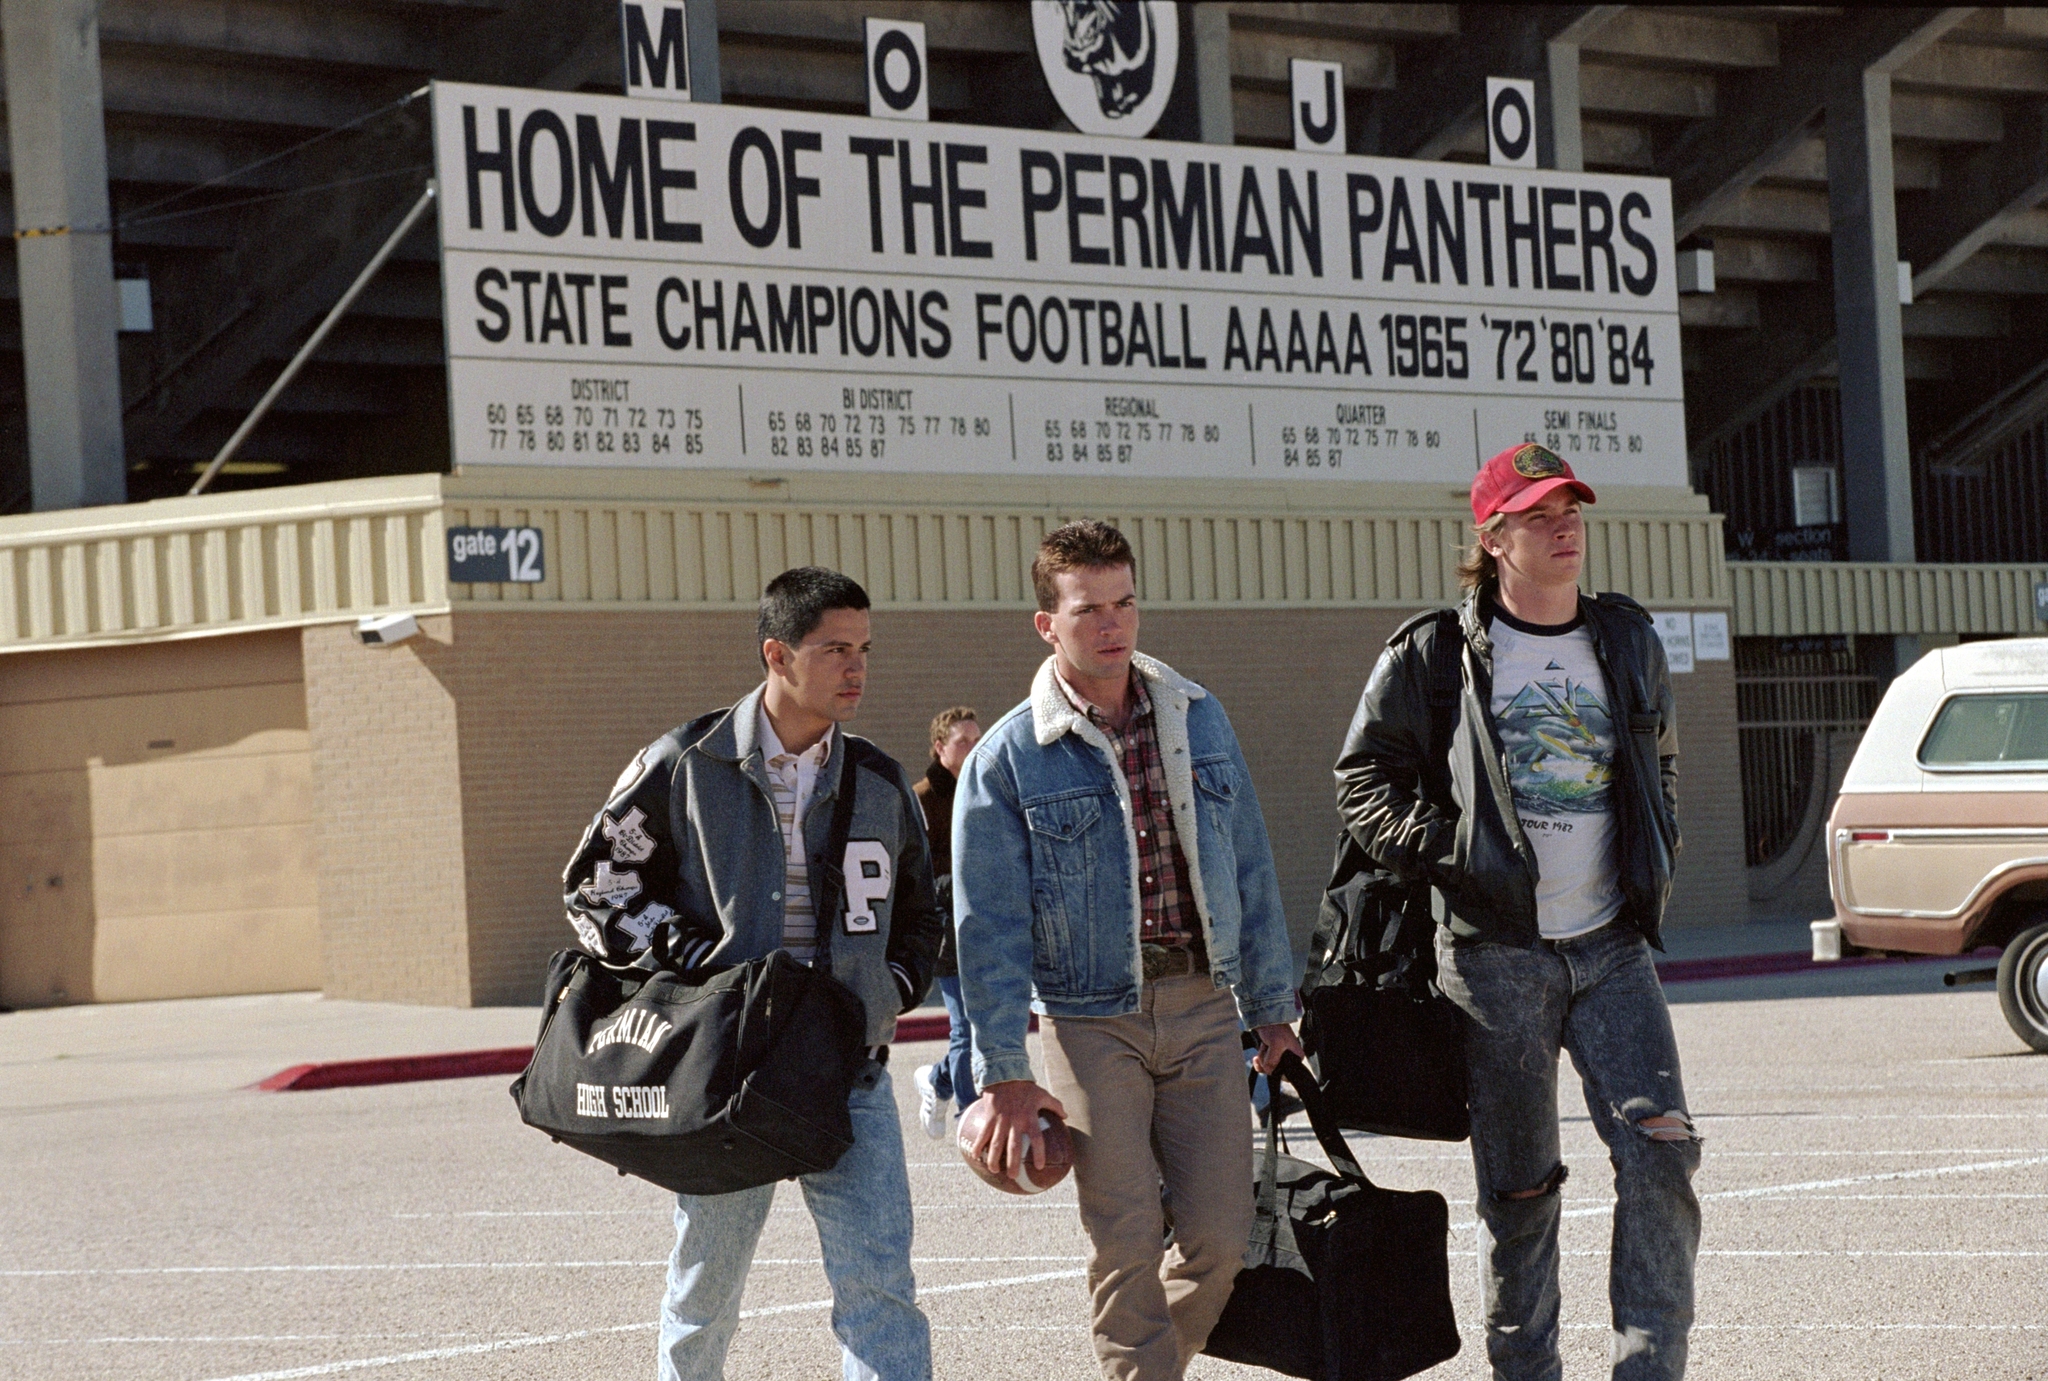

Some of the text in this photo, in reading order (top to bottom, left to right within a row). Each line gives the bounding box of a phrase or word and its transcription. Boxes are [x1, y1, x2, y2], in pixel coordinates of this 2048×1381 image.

[625, 4, 1532, 160] M O J O
[462, 105, 1658, 297] HOME OF THE PERMIAN PANTHERS
[474, 267, 632, 347] STATE
[656, 276, 952, 359] CHAMPIONS
[976, 292, 1207, 370] FOOTBALL
[1223, 306, 1373, 376] AAAAA
[1379, 313, 1469, 379] 1965
[571, 379, 629, 402] DISTRICT
[843, 388, 912, 411] BI DISTRICT
[487, 404, 703, 429] 60 65 68 70 71 72 73 75
[1105, 396, 1159, 419] REGIONAL
[1336, 403, 1386, 425] QUARTER
[769, 411, 990, 437] 65 68 70 72 73 75 77 78 80
[1045, 420, 1220, 443] 65 68 70 72 75 77 78 80
[1544, 409, 1617, 432] SEMI FINALS
[489, 429, 703, 455] 77 78 80 81 82 83 84 85
[771, 436, 885, 458] 82 83 84 85 87
[1282, 426, 1440, 448] 65 68 70 72 75 77 78 80
[1547, 432, 1560, 451] 68
[1568, 433, 1581, 452] 70
[1587, 434, 1600, 452] 72
[1608, 435, 1620, 453] 75
[1628, 435, 1642, 453] 80
[1047, 443, 1133, 463] 83 84 85 87
[1284, 449, 1343, 468] 84 85 87
[453, 528, 541, 581] gate 12
[1497, 675, 1612, 720] ASIA
[1521, 818, 1549, 830] TOUR
[841, 839, 892, 934] P
[576, 1083, 670, 1118] HIGH SCHOOL
